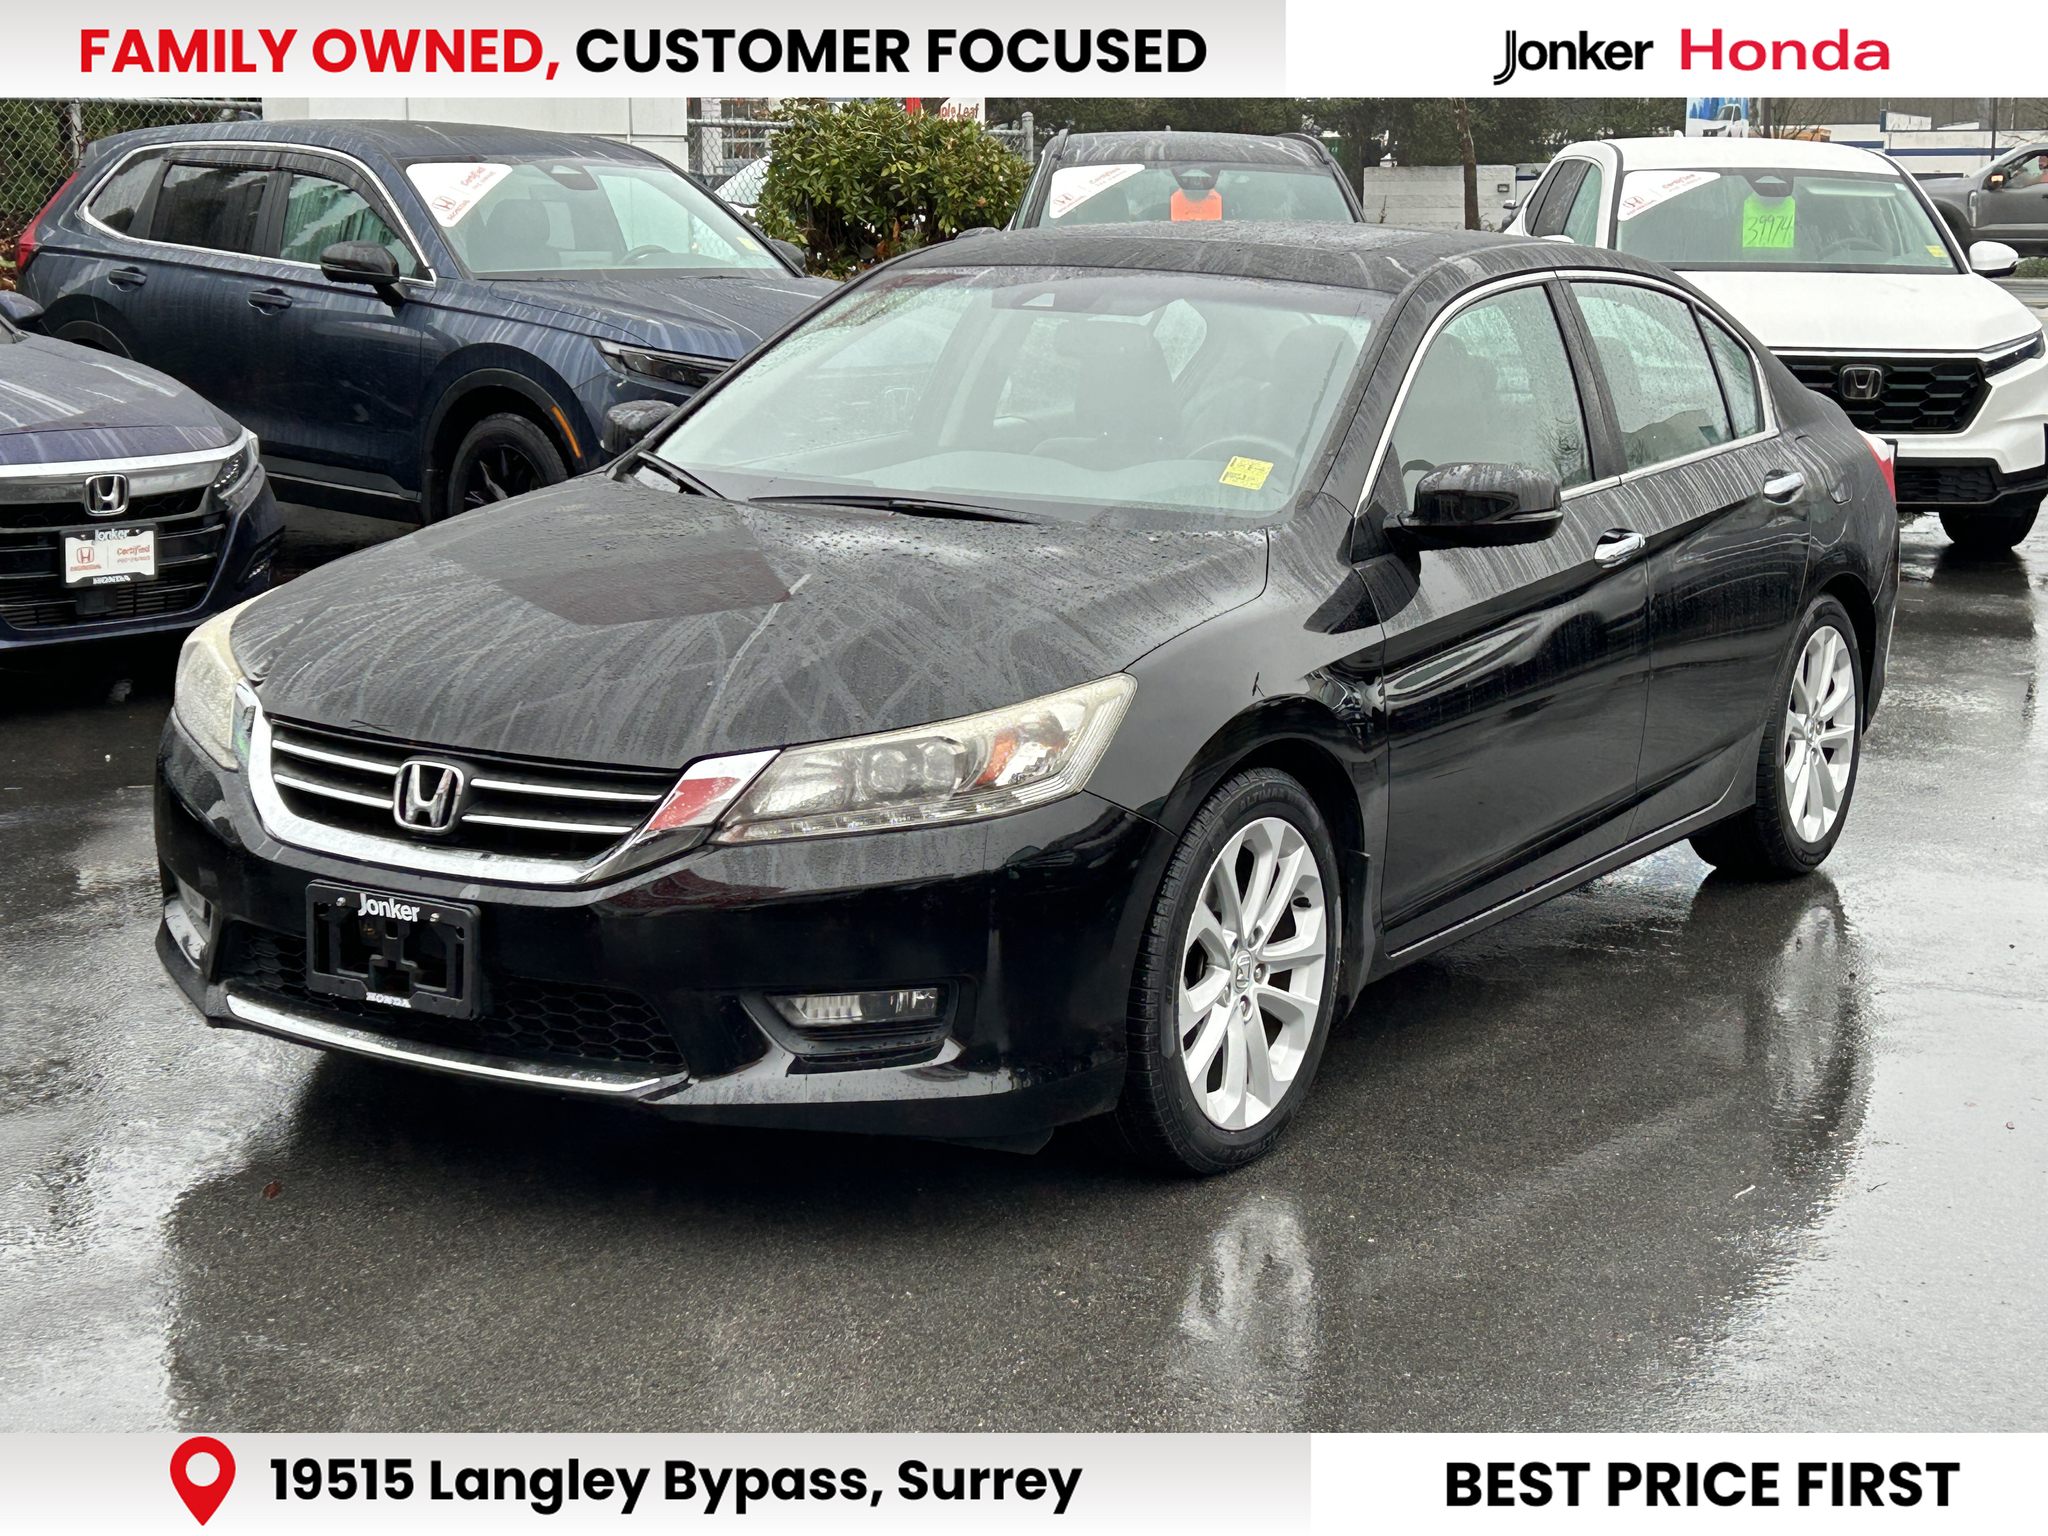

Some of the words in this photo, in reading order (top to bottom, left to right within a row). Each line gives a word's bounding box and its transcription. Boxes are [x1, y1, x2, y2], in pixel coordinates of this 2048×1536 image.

[91, 529, 130, 545] Jonker
[358, 893, 420, 922] Jonker
[366, 992, 411, 1008] HONDA
